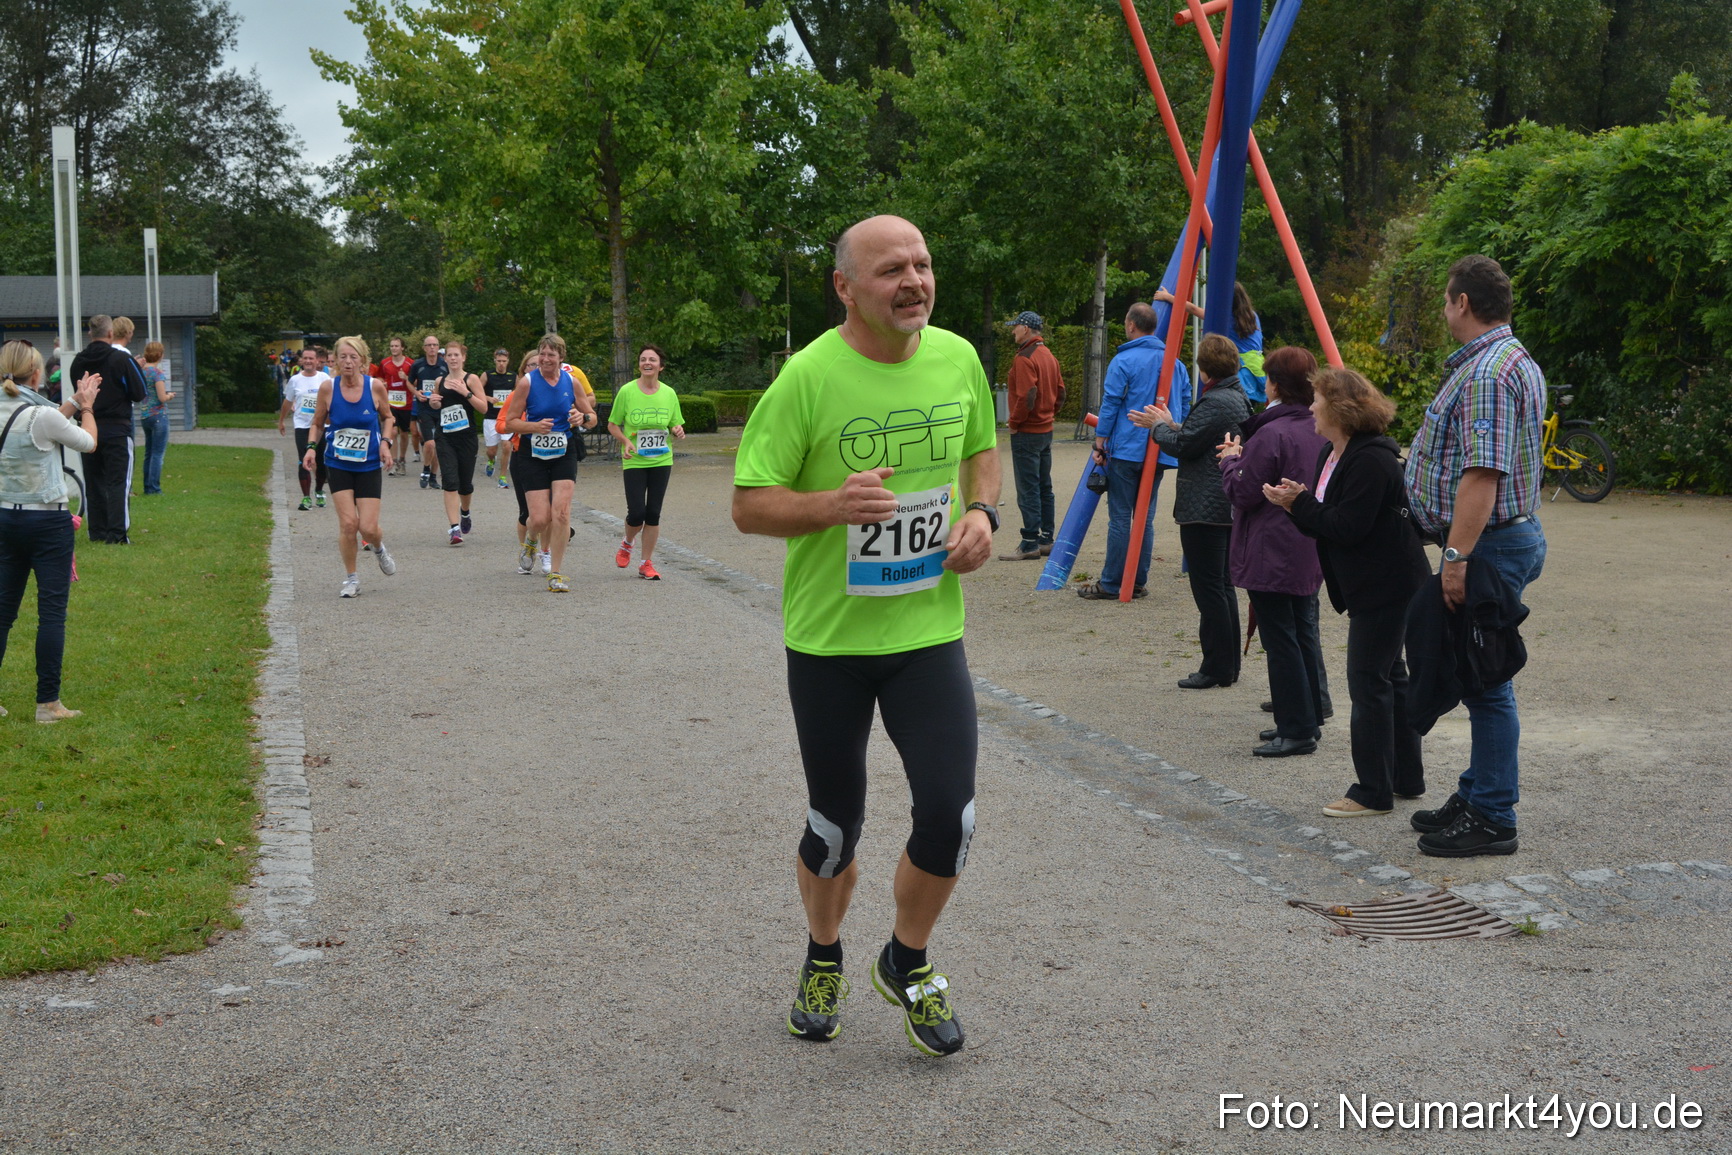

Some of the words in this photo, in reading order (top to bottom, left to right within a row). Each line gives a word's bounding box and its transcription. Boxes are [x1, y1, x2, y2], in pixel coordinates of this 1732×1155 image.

[303, 399, 318, 408] 265
[443, 410, 464, 424] 2461
[630, 407, 669, 425] OPF
[336, 434, 366, 449] 2722
[535, 436, 564, 448] 2326
[640, 435, 665, 448] 2372
[839, 401, 964, 473] OPF
[894, 498, 938, 514] Neumarkt
[859, 511, 943, 557] 2162
[881, 562, 925, 582] Robert
